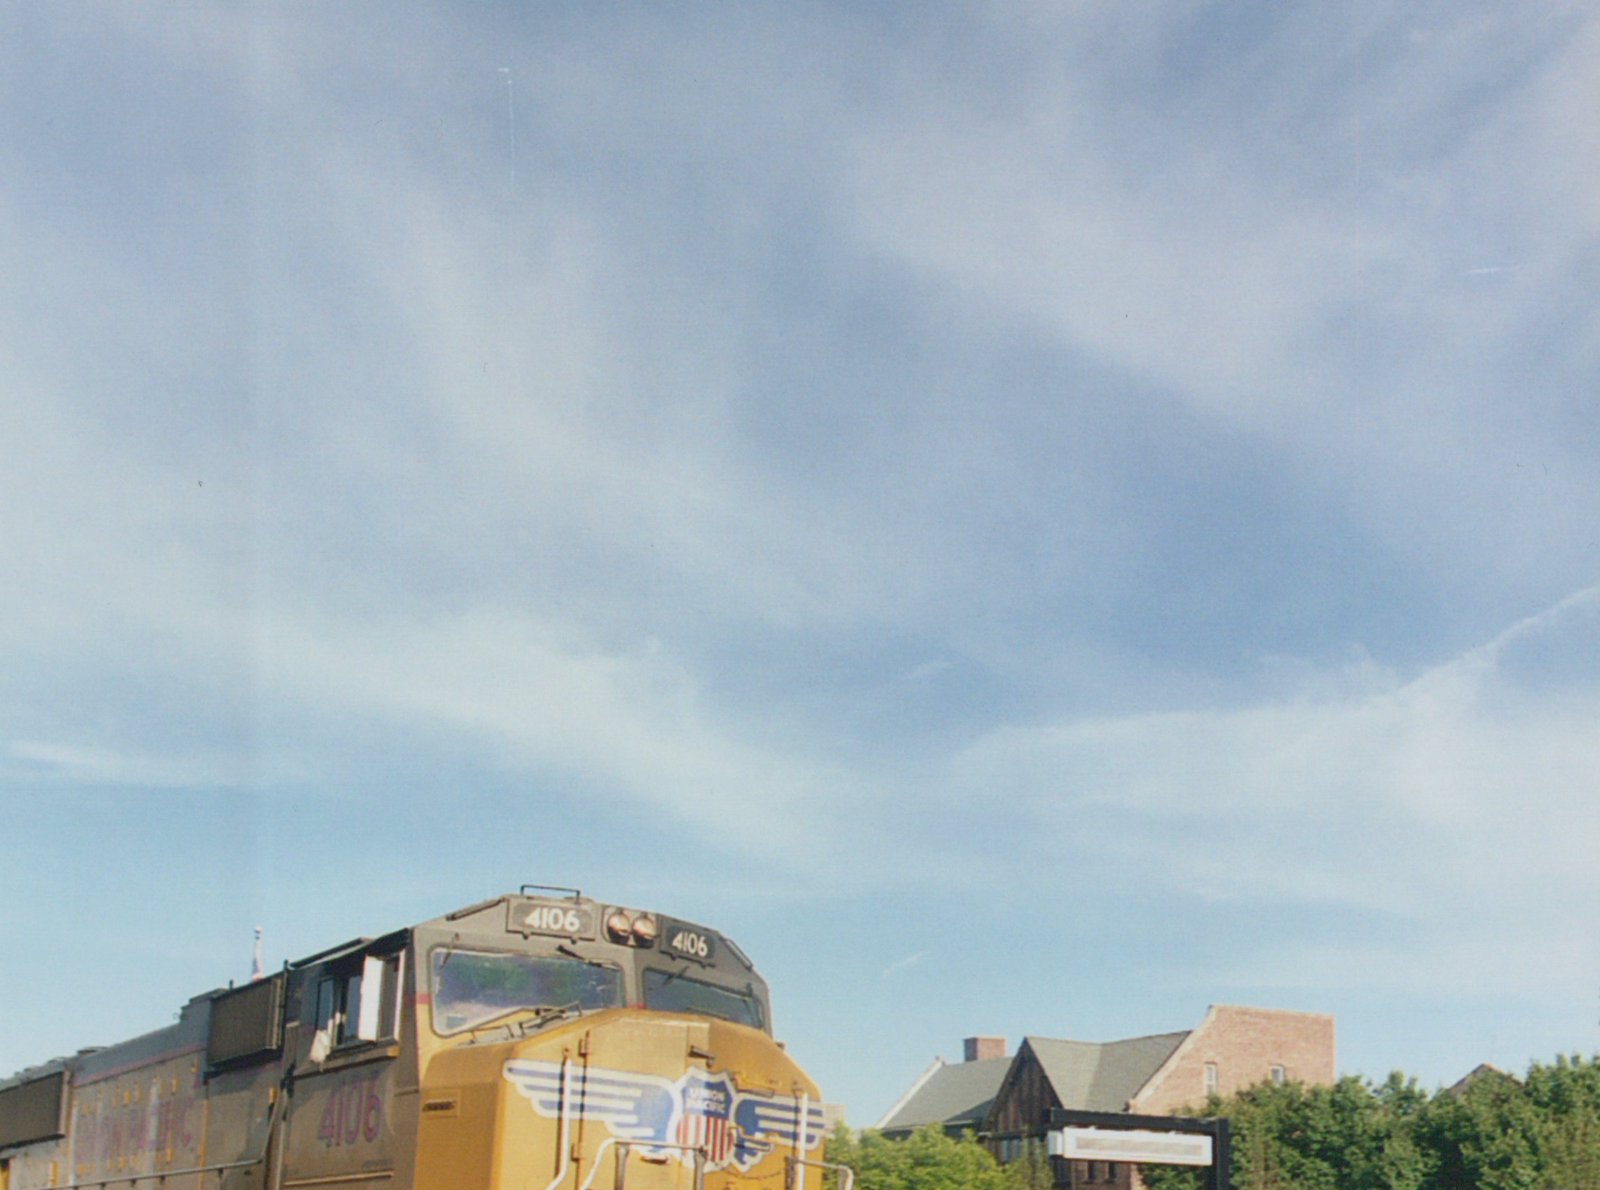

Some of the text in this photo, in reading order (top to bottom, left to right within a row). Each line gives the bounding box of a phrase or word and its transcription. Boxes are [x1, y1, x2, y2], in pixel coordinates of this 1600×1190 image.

[525, 906, 581, 932] 4106
[671, 930, 709, 958] 4106
[316, 1070, 383, 1149] 4106
